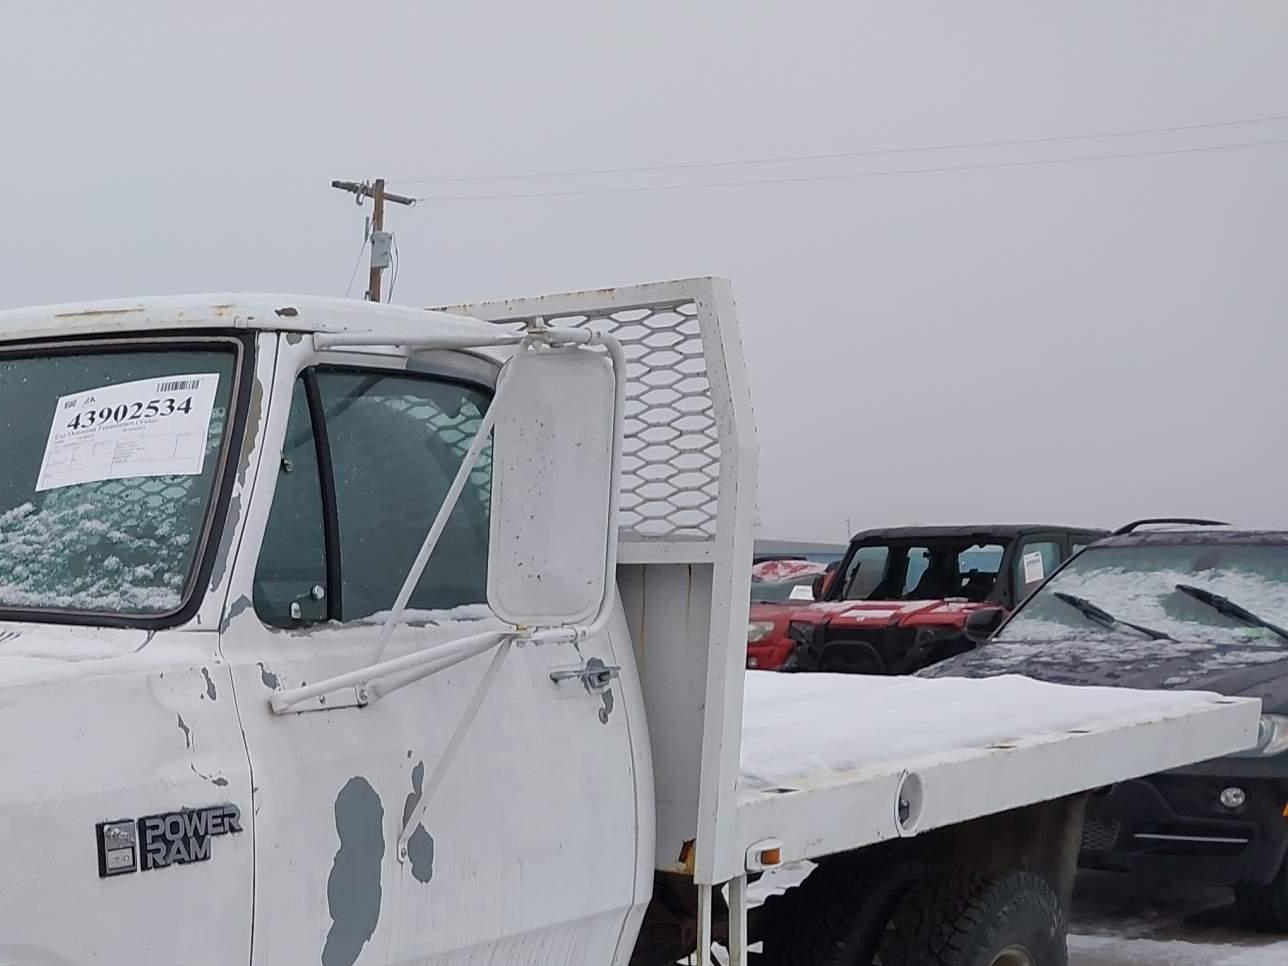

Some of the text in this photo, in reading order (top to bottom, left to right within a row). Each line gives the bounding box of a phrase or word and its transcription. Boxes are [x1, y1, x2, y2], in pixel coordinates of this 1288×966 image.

[67, 396, 192, 430] 43902534
[145, 805, 243, 844] POWER
[146, 836, 211, 869] RAM
